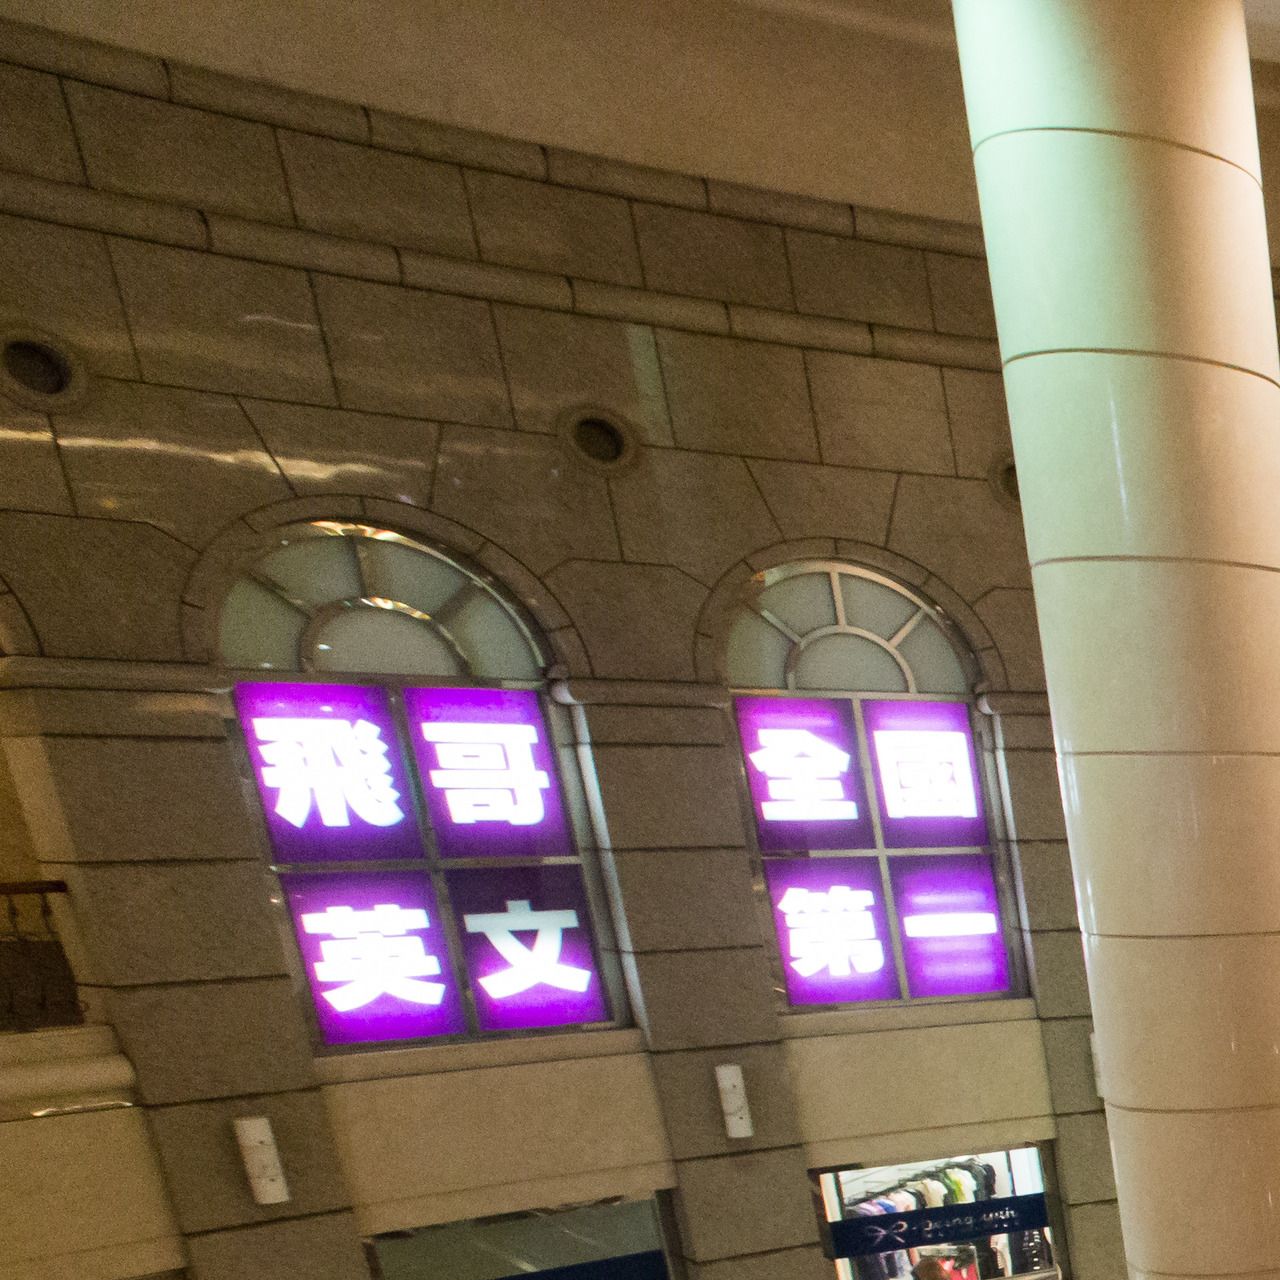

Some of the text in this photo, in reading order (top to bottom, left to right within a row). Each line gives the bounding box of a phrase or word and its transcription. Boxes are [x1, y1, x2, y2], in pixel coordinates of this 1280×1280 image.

[252, 717, 551, 829] 飛哥
[748, 727, 979, 822] 全國
[300, 900, 592, 1013] 英文
[776, 885, 999, 981] 第一
